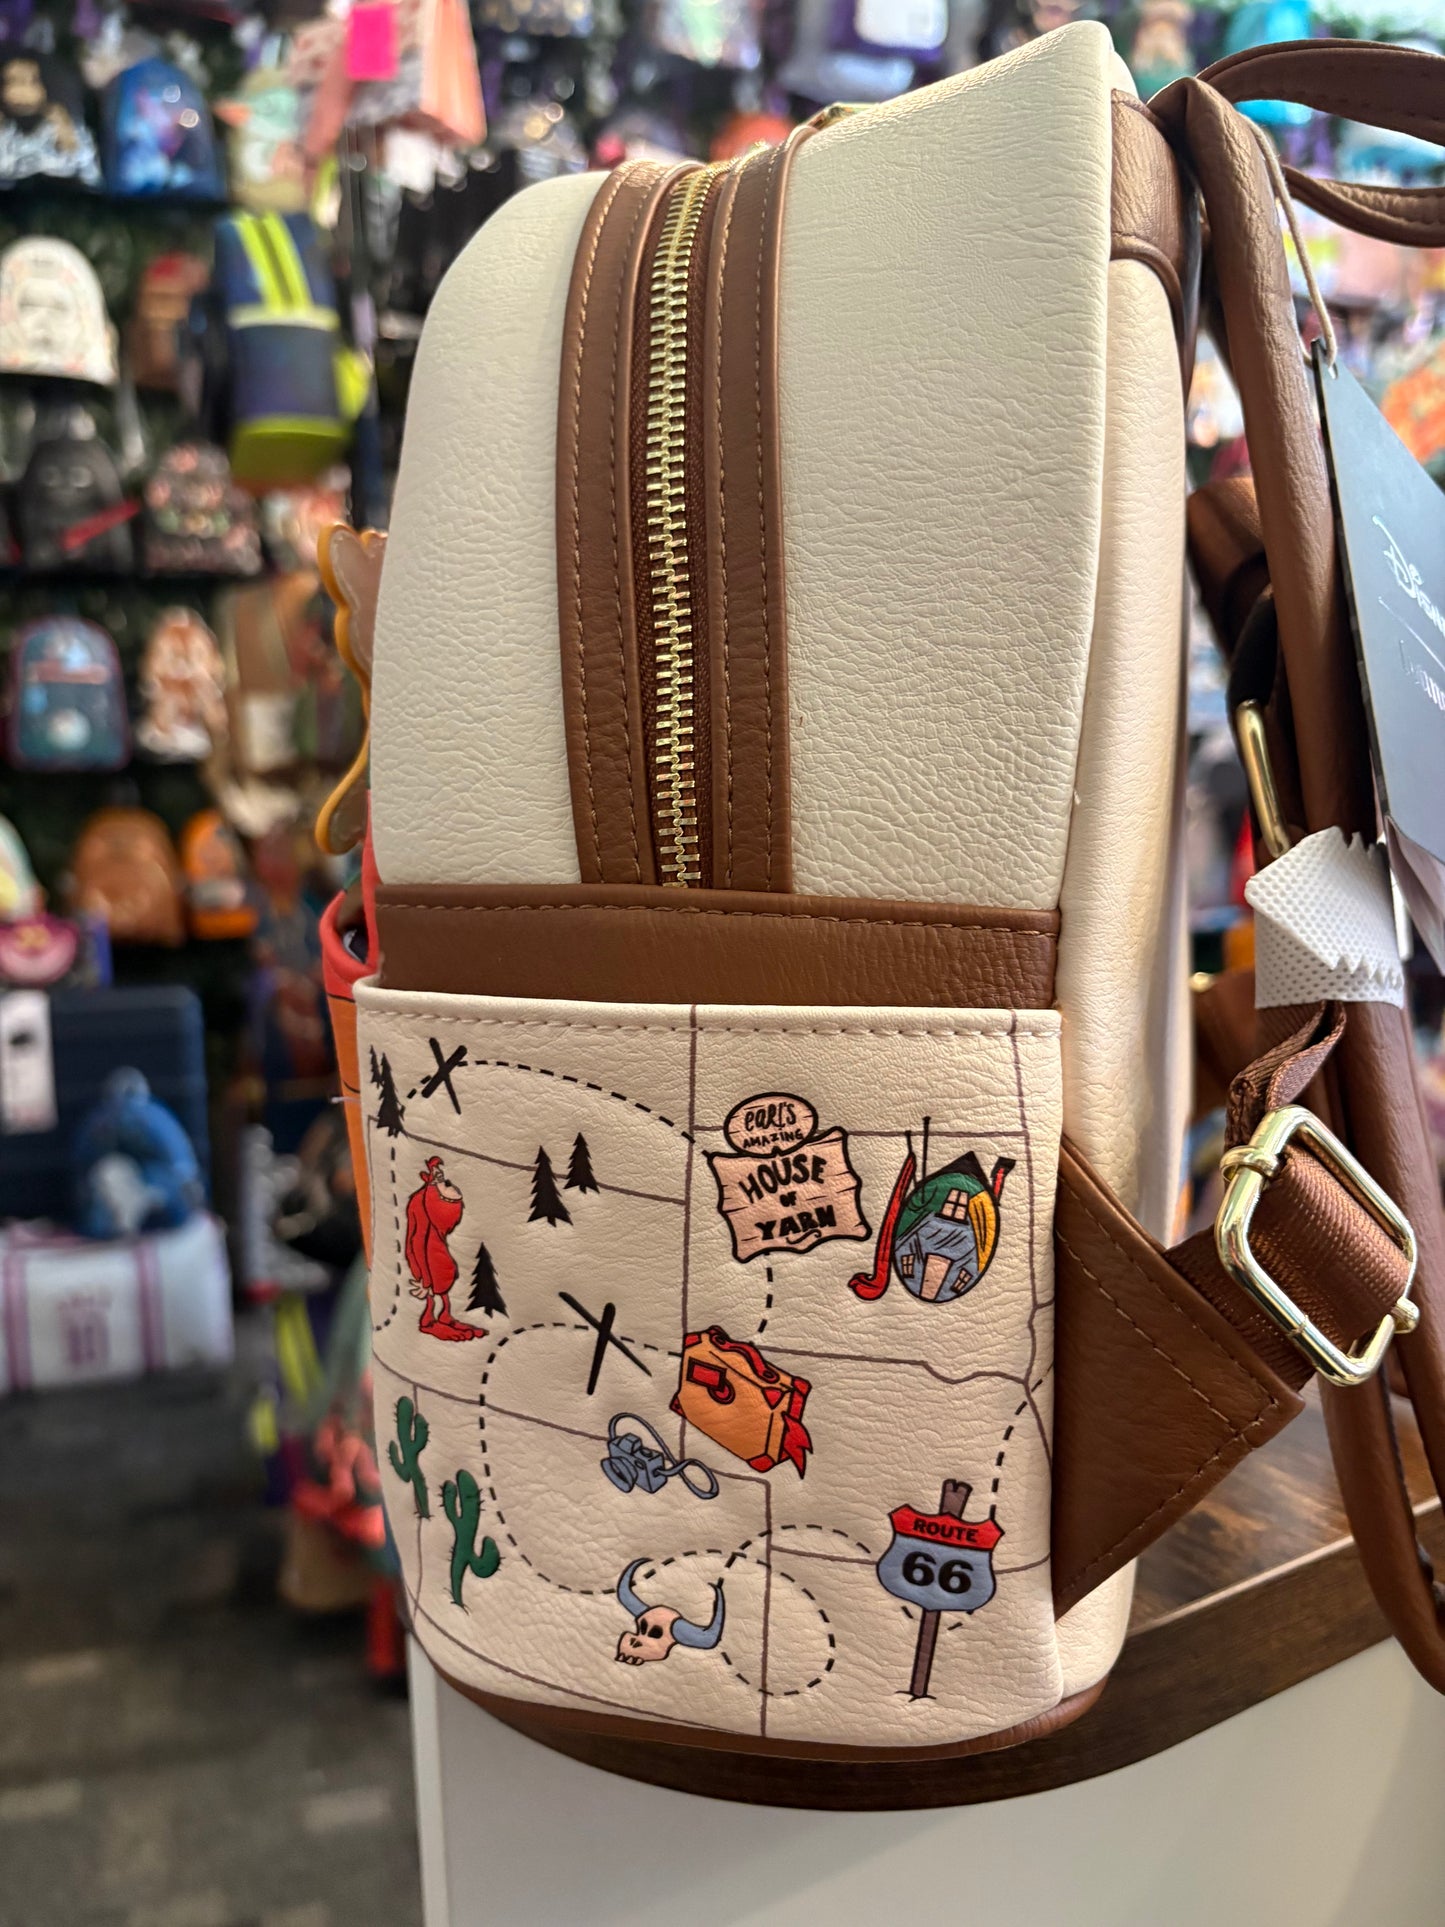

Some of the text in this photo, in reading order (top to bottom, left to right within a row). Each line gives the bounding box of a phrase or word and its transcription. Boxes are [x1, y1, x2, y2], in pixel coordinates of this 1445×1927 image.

[743, 1128, 804, 1149] AMAZING
[738, 1153, 827, 1204] HOUSE
[754, 1204, 837, 1241] YARN
[913, 1517, 979, 1543] ROUTE
[902, 1551, 974, 1594] 66
